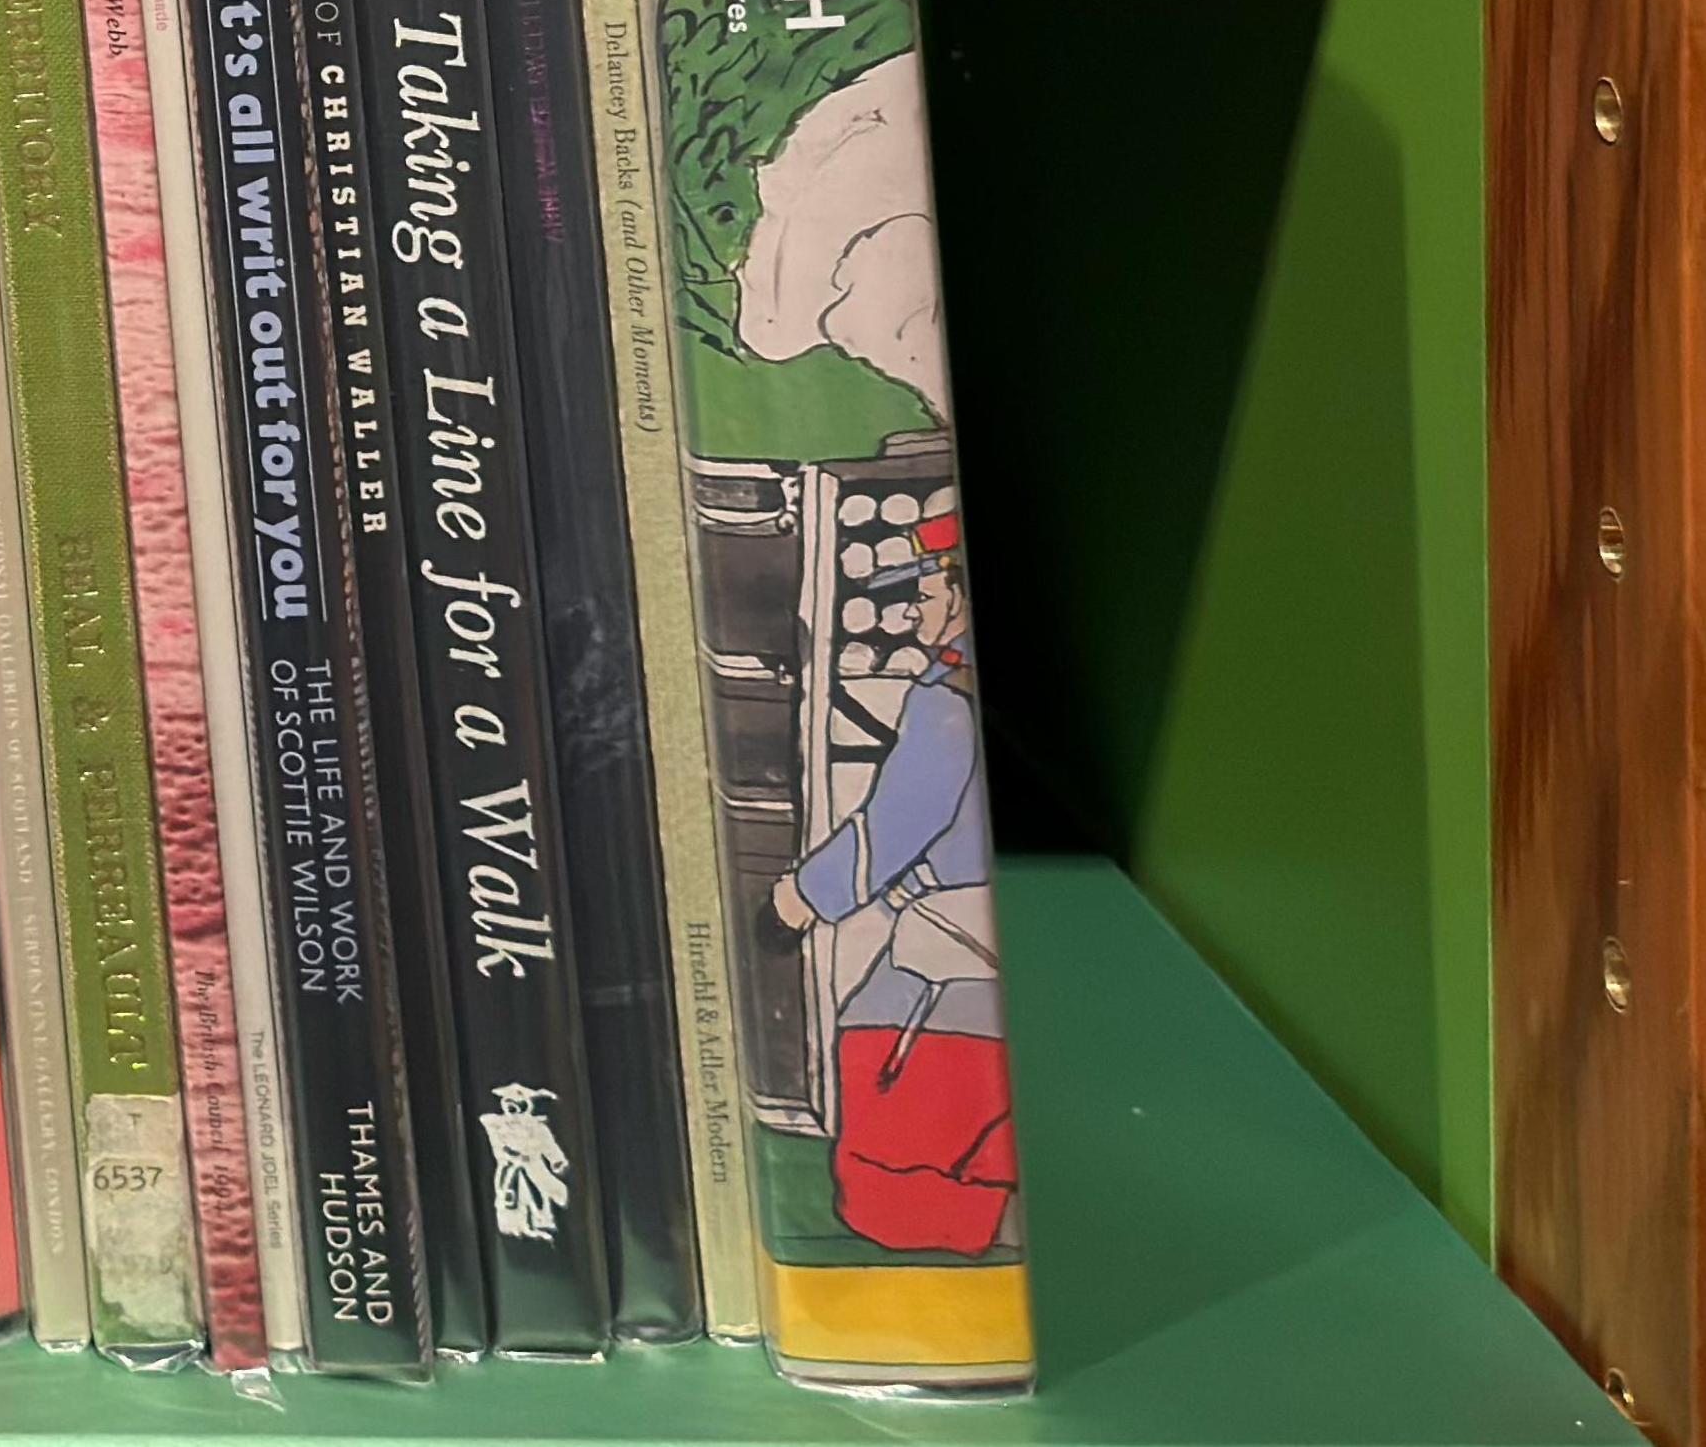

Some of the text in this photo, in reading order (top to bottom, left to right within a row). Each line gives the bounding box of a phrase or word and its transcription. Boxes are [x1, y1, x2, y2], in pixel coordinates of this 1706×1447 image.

[313, 2, 343, 47] OF
[603, 21, 632, 119] Delancey
[392, 11, 481, 272] Taking
[612, 129, 639, 190] Backs
[322, 64, 369, 329] CHRISTIAN
[616, 198, 645, 250] (and
[418, 297, 463, 341] a
[624, 256, 649, 316] Other
[227, 94, 310, 620] all writ out for you
[627, 324, 661, 433] Moments)
[347, 349, 387, 534] WALLER
[424, 366, 498, 540] Line
[423, 558, 520, 677] for
[455, 705, 500, 751] a
[270, 659, 326, 993] OF SCOTTIE WILSON
[305, 660, 363, 1003] THE LIFE AND WORK
[459, 778, 553, 981] Walk
[253, 1063, 274, 1150] LEONARD
[698, 1030, 723, 1091] Adler
[92, 1164, 164, 1193] 6537
[262, 1153, 278, 1196] JOEL
[703, 1099, 730, 1184] Modern
[318, 1171, 358, 1321] HUDSON
[347, 1101, 393, 1326] THAMES AND
